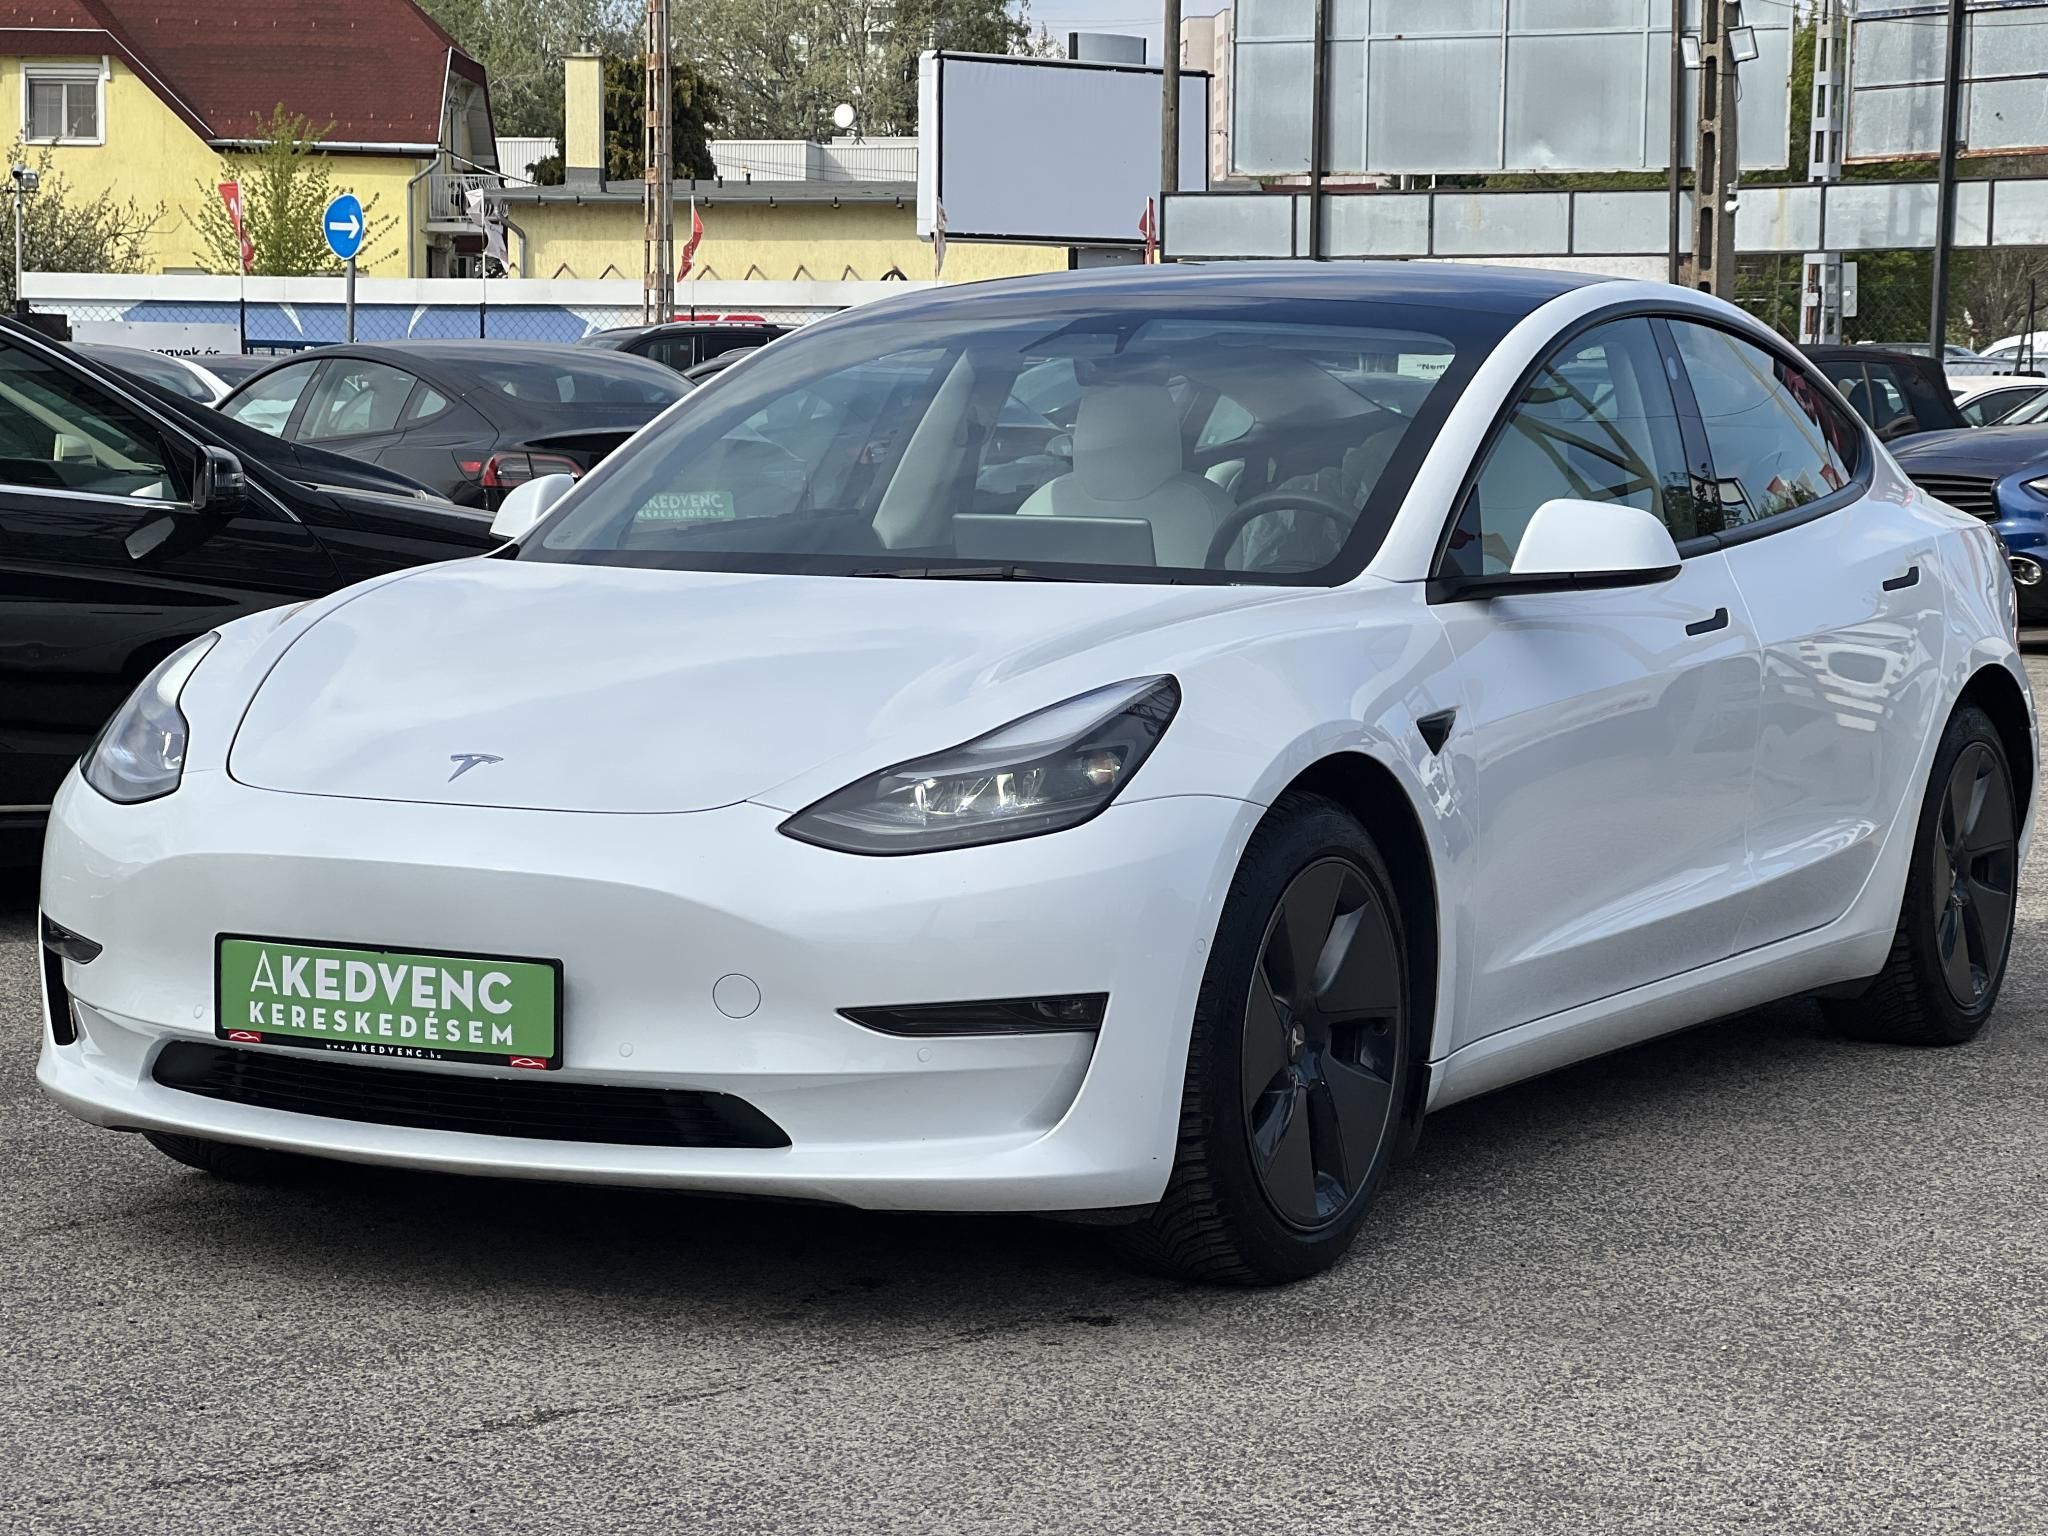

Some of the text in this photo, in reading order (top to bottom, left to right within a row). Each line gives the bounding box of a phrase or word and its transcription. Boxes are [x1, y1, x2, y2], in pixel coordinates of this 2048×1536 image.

[249, 949, 512, 1015] AKEDVENC
[249, 1000, 513, 1046] KERESKEDÉSEM
[326, 1043, 442, 1059] www.AKEDVENC.hu
